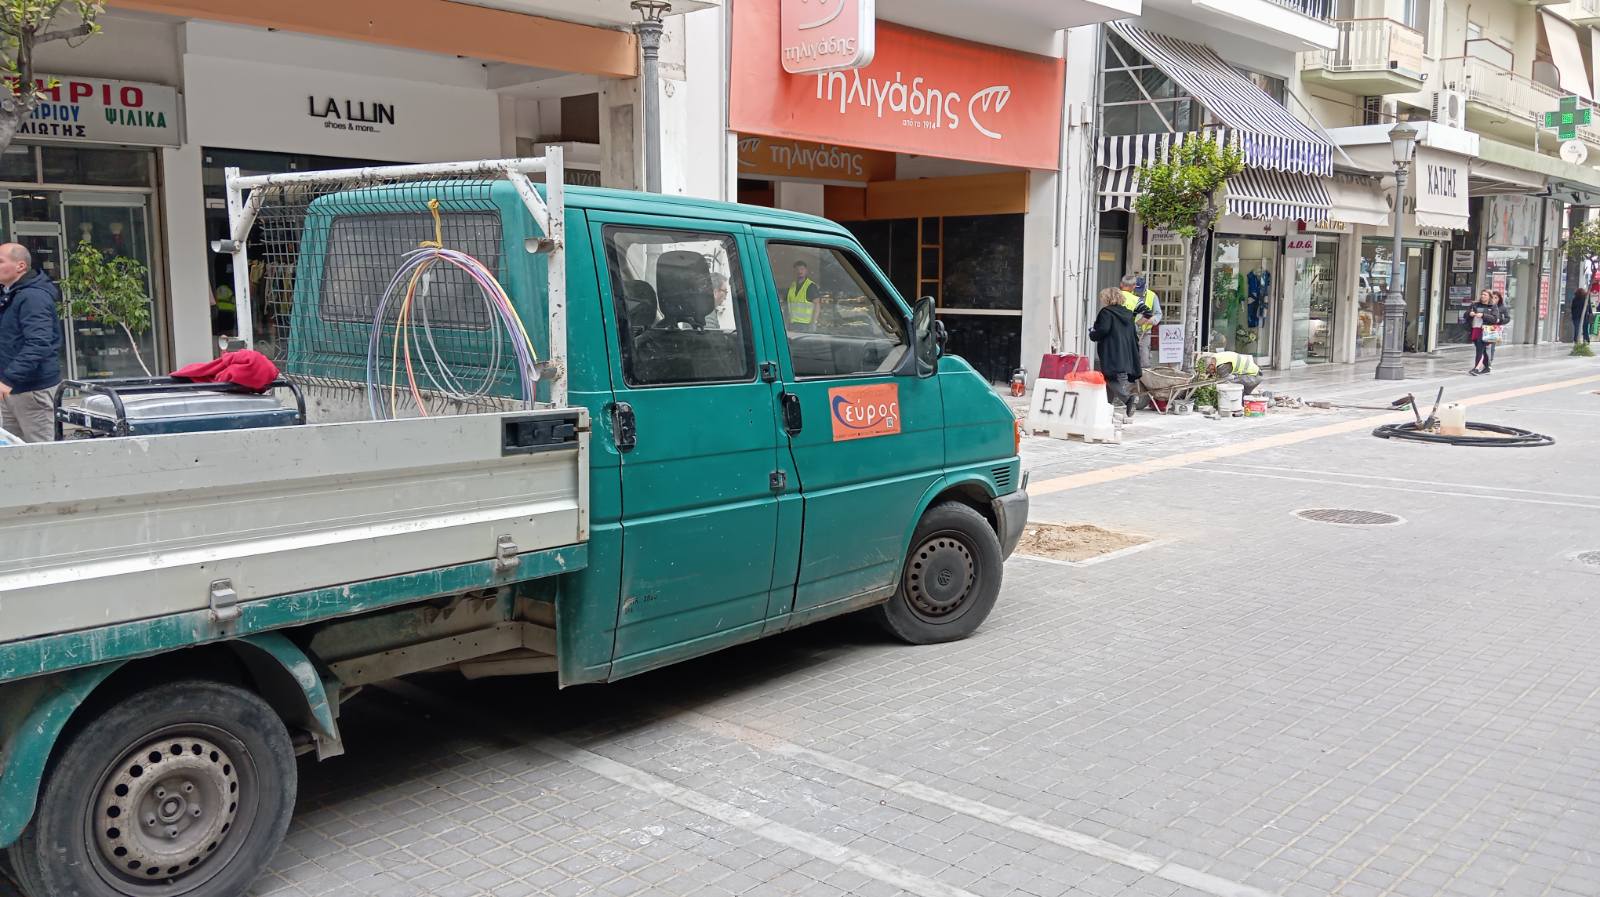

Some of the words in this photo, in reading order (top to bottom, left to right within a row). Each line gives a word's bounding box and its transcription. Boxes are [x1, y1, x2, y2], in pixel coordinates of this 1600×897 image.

[785, 36, 856, 63] τηλιγάδης
[105, 107, 167, 129] ΨΙΛΙΚΑ
[308, 95, 341, 119] LA
[16, 121, 87, 138] ΛΙΩΤΗΣ
[324, 121, 346, 130] shoes
[348, 122, 353, 131] &
[769, 142, 864, 176] τηλιγάδης
[1427, 164, 1457, 198] ΧΑΤΖΗΣ
[1287, 240, 1313, 250] A.D.G.
[845, 399, 898, 425] εύρος
[1040, 388, 1079, 419] ΕΠ
